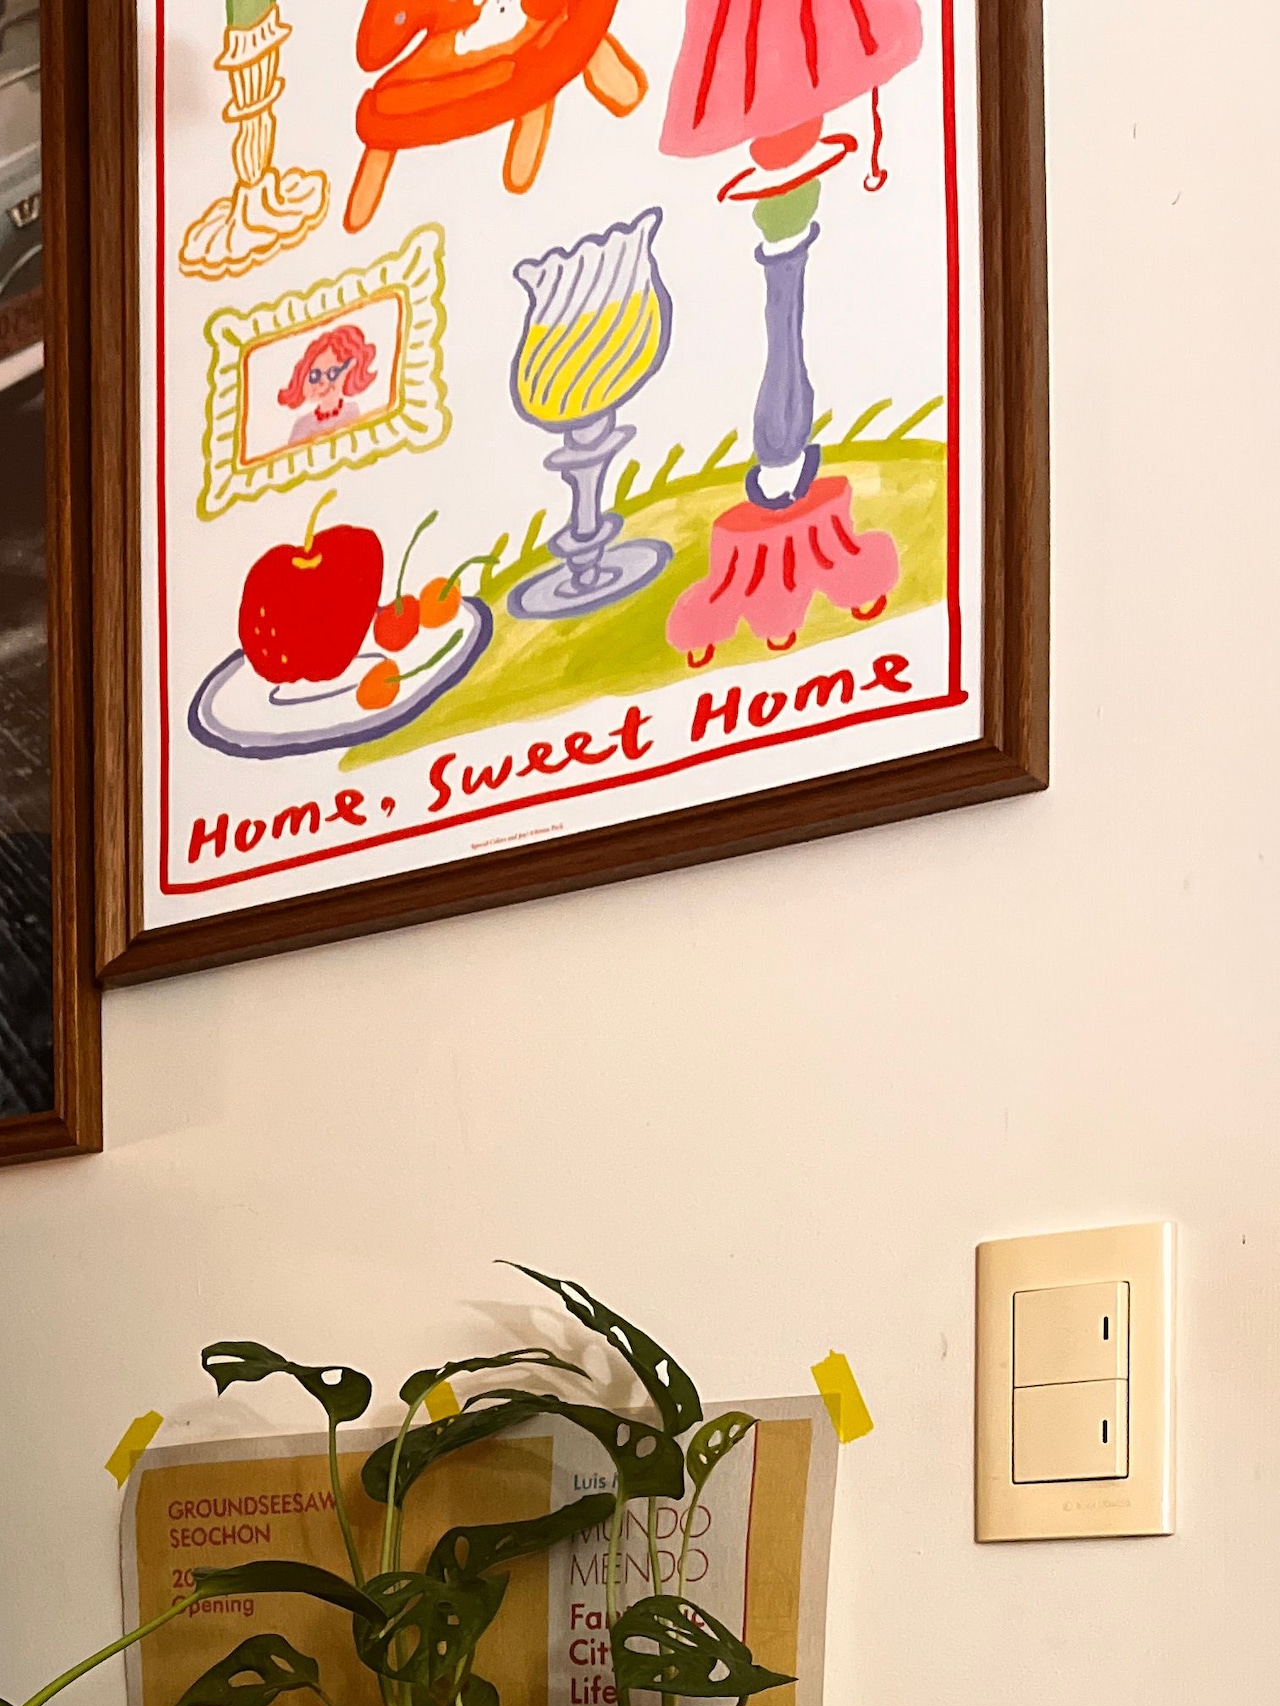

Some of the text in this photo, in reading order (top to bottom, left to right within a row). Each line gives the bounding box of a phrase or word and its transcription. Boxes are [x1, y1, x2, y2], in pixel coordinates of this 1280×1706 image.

[187, 651, 914, 864] Home, Sweet Home
[573, 1473, 606, 1491] Luis
[168, 1490, 337, 1521] GROUNDSEESAW
[170, 1523, 270, 1549] SEOCHON
[570, 1548, 709, 1586] MENDO
[172, 1595, 255, 1618] Opening
[569, 1637, 617, 1673] Cit
[570, 1676, 618, 1705] Life
